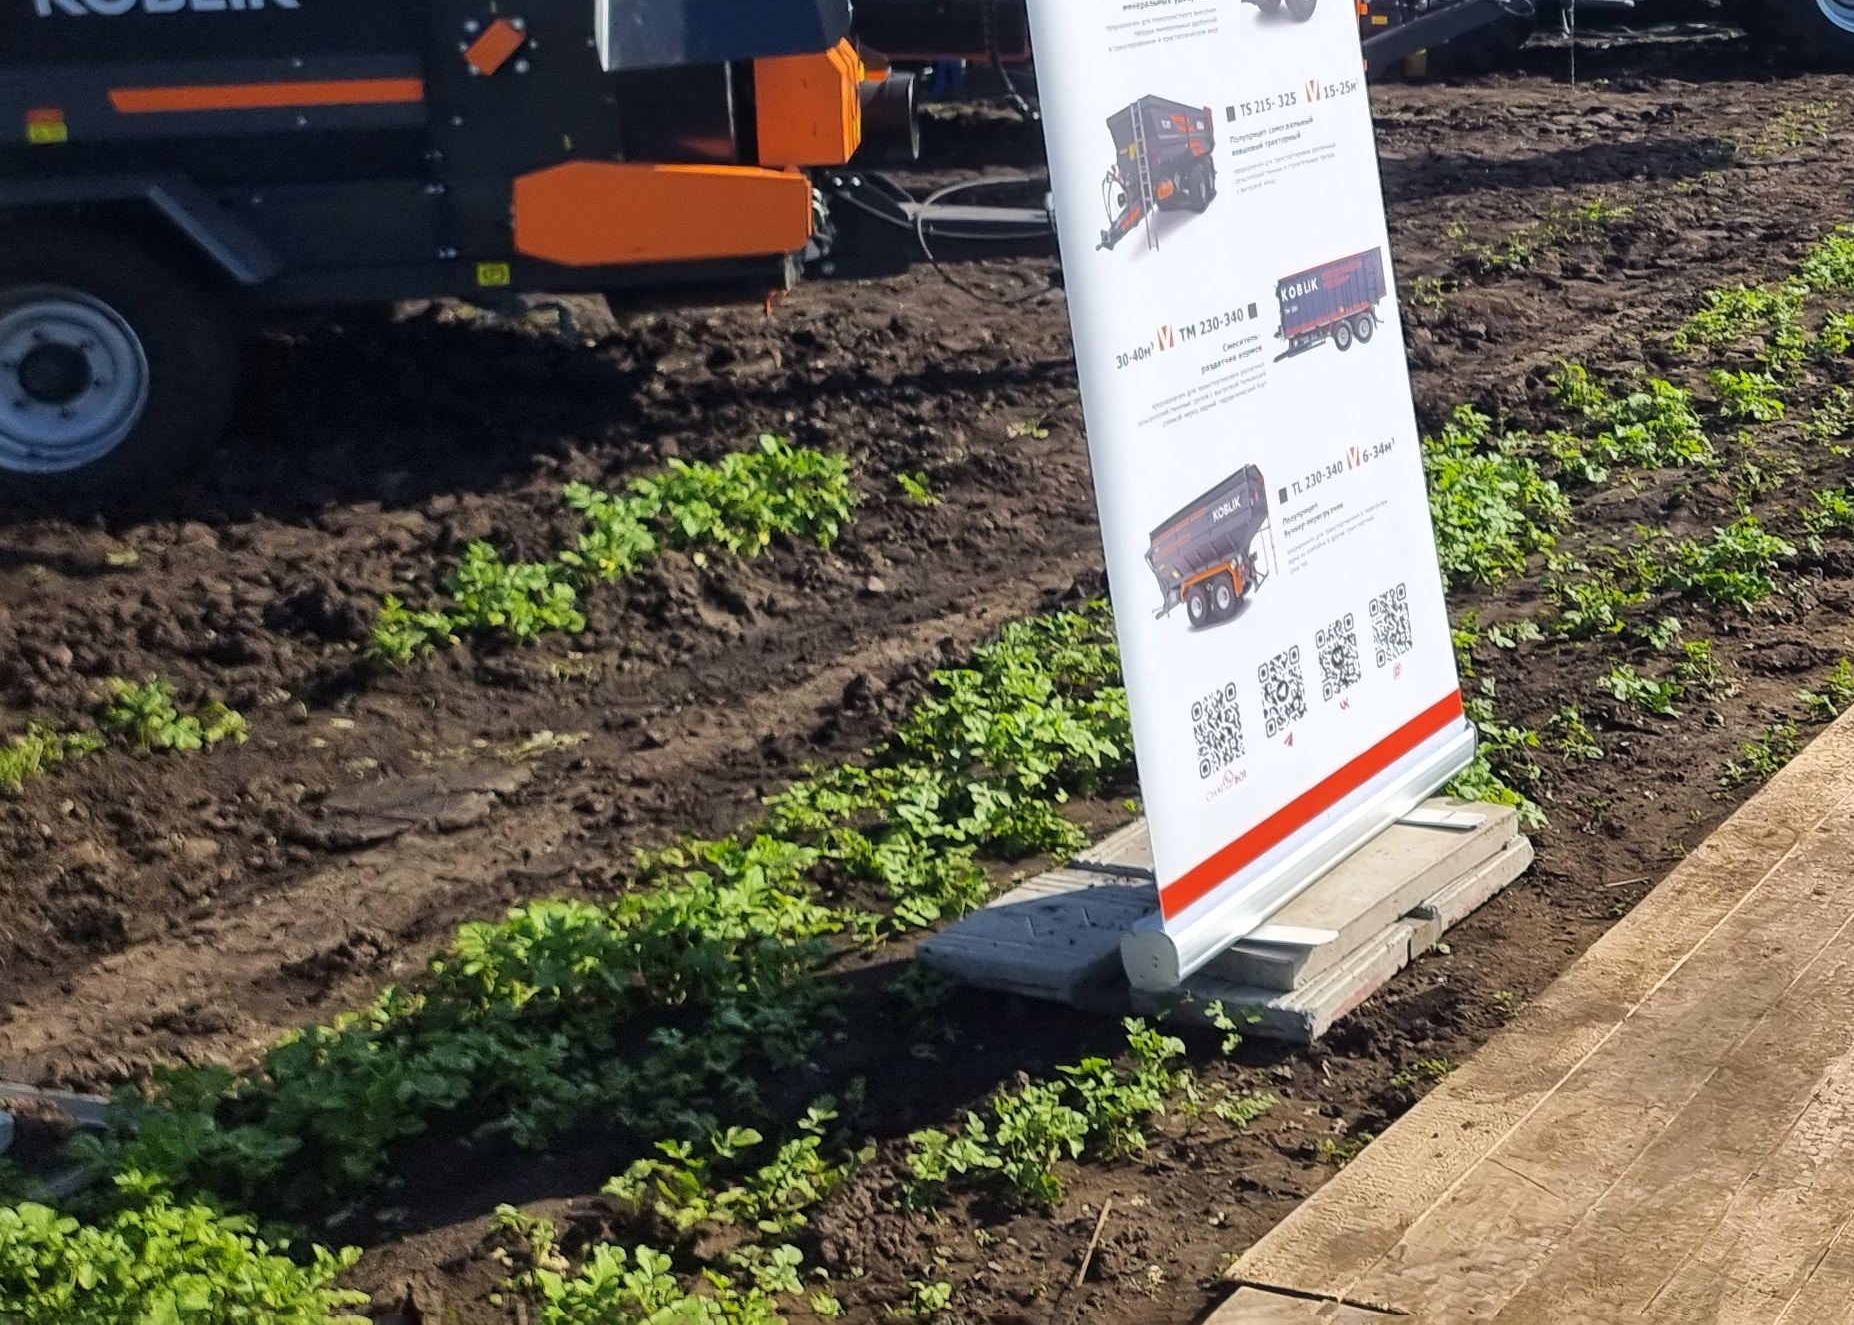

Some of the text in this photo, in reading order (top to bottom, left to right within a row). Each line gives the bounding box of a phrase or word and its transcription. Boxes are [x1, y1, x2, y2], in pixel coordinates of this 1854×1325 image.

[1240, 102, 1253, 117] TS
[1178, 307, 1244, 342] TM 230-340
[1291, 460, 1344, 497] TL 230-340
